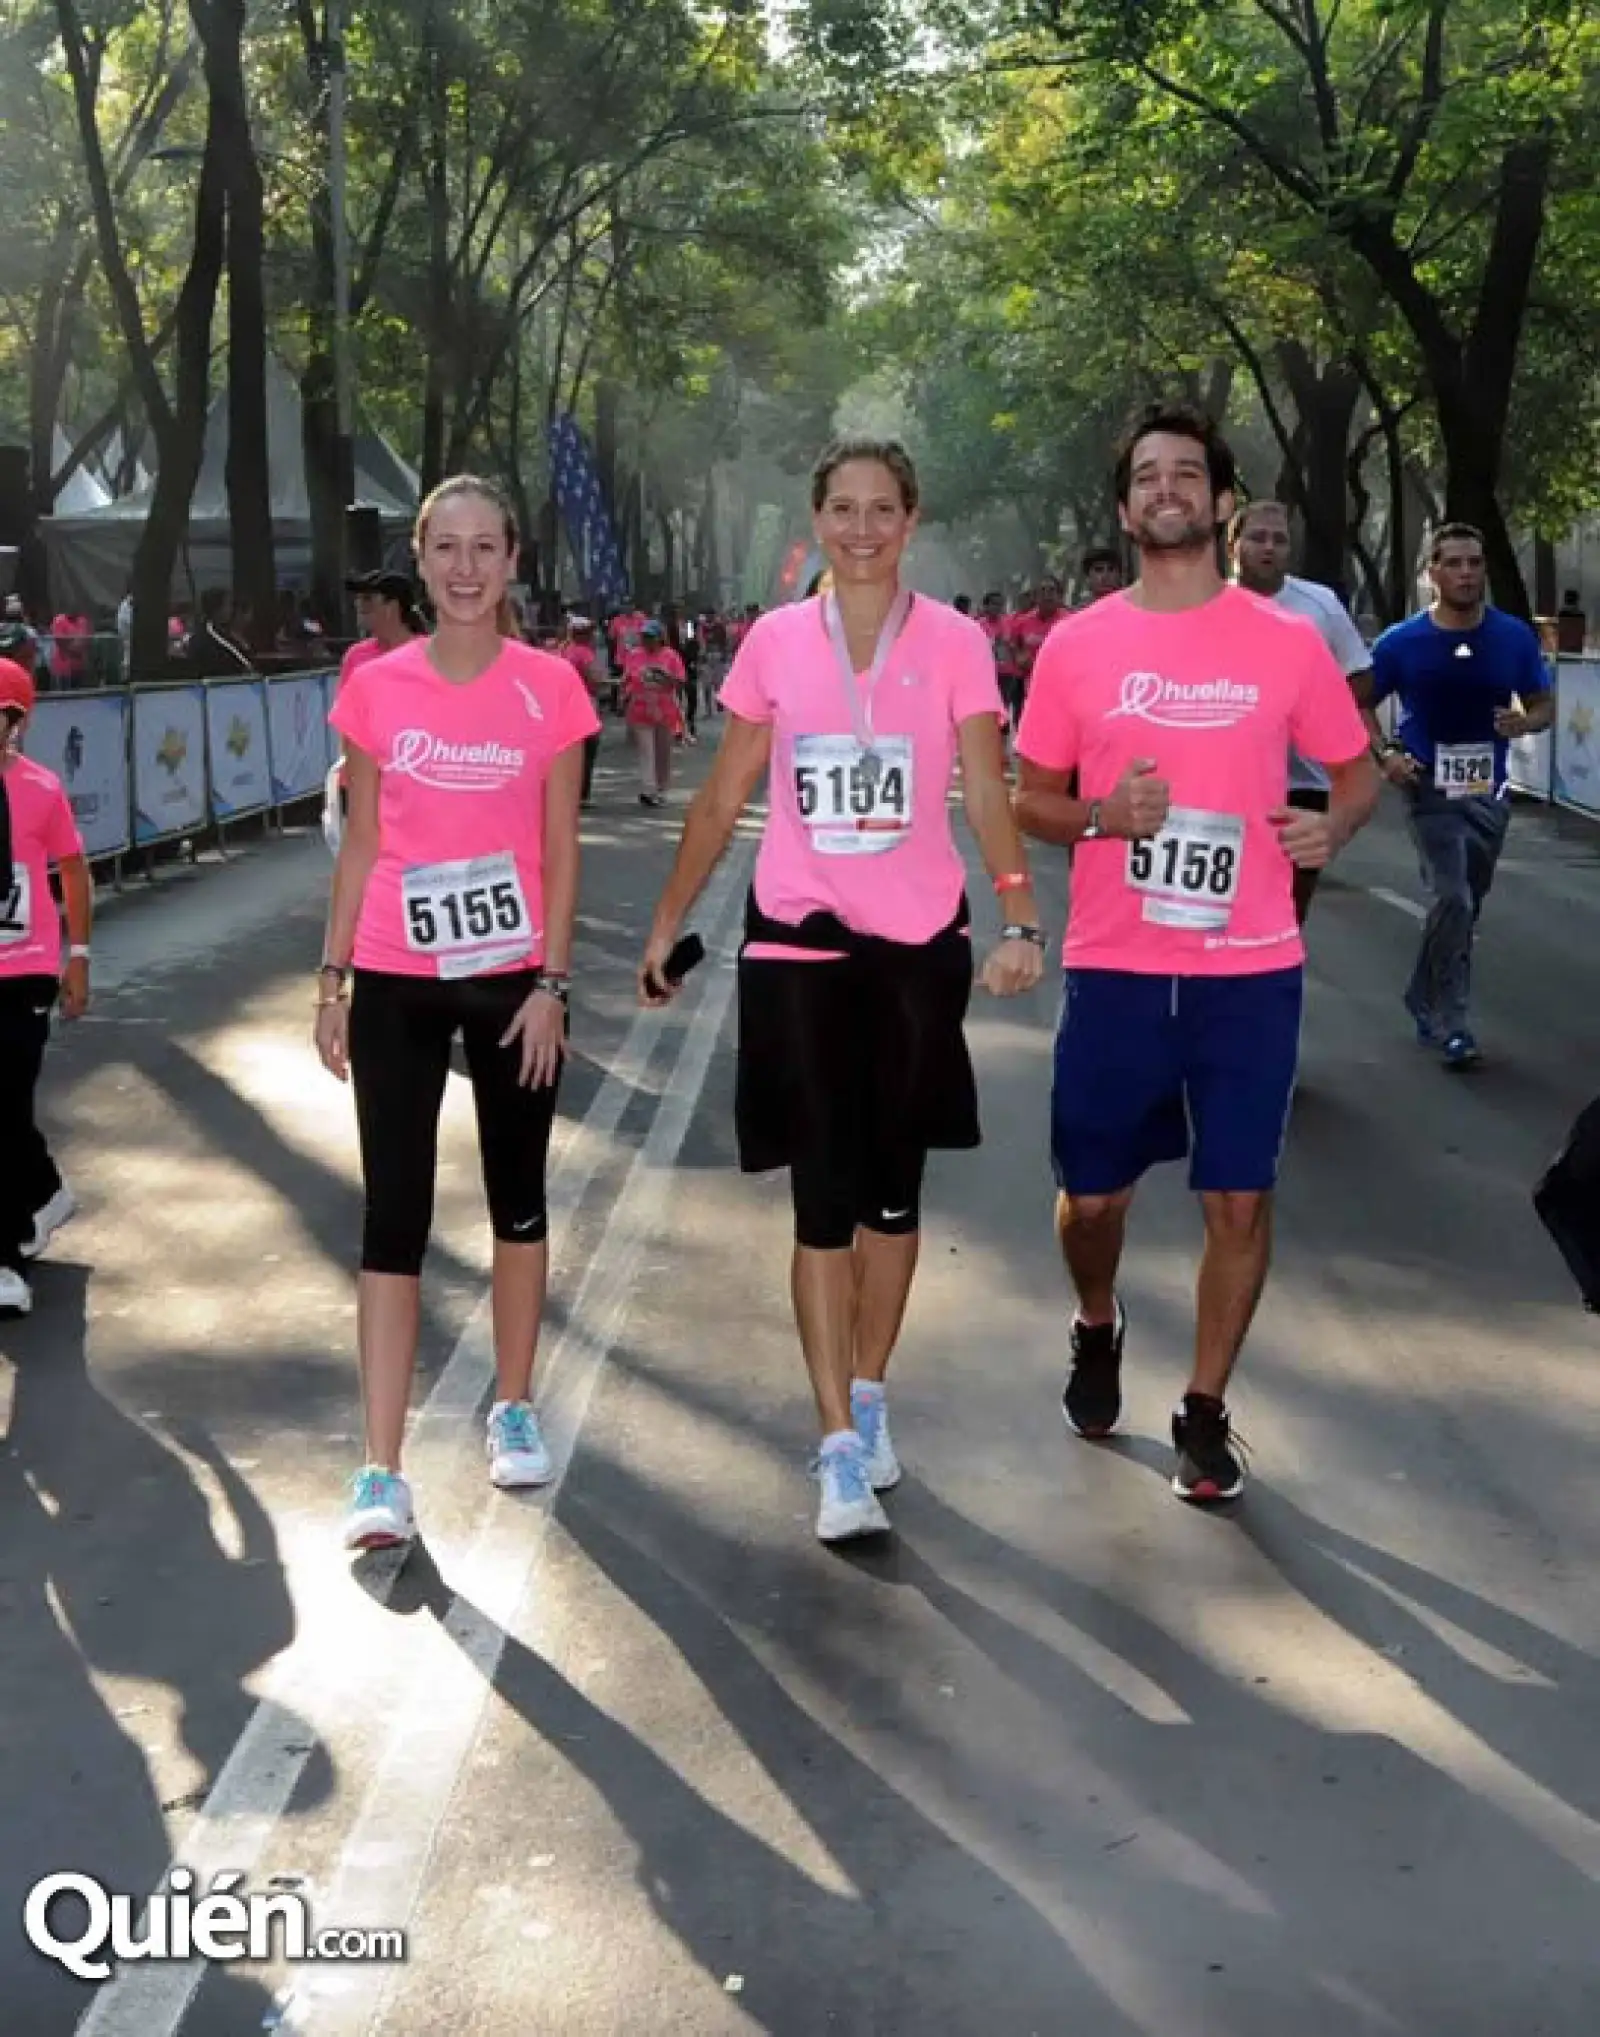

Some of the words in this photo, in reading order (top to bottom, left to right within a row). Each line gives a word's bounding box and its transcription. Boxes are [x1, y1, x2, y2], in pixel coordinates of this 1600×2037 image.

[1164, 678, 1259, 703] huellas
[433, 738, 525, 766] huellas
[795, 766, 904, 816] 5154
[1130, 836, 1235, 895] 5158
[407, 881, 522, 945] 5155
